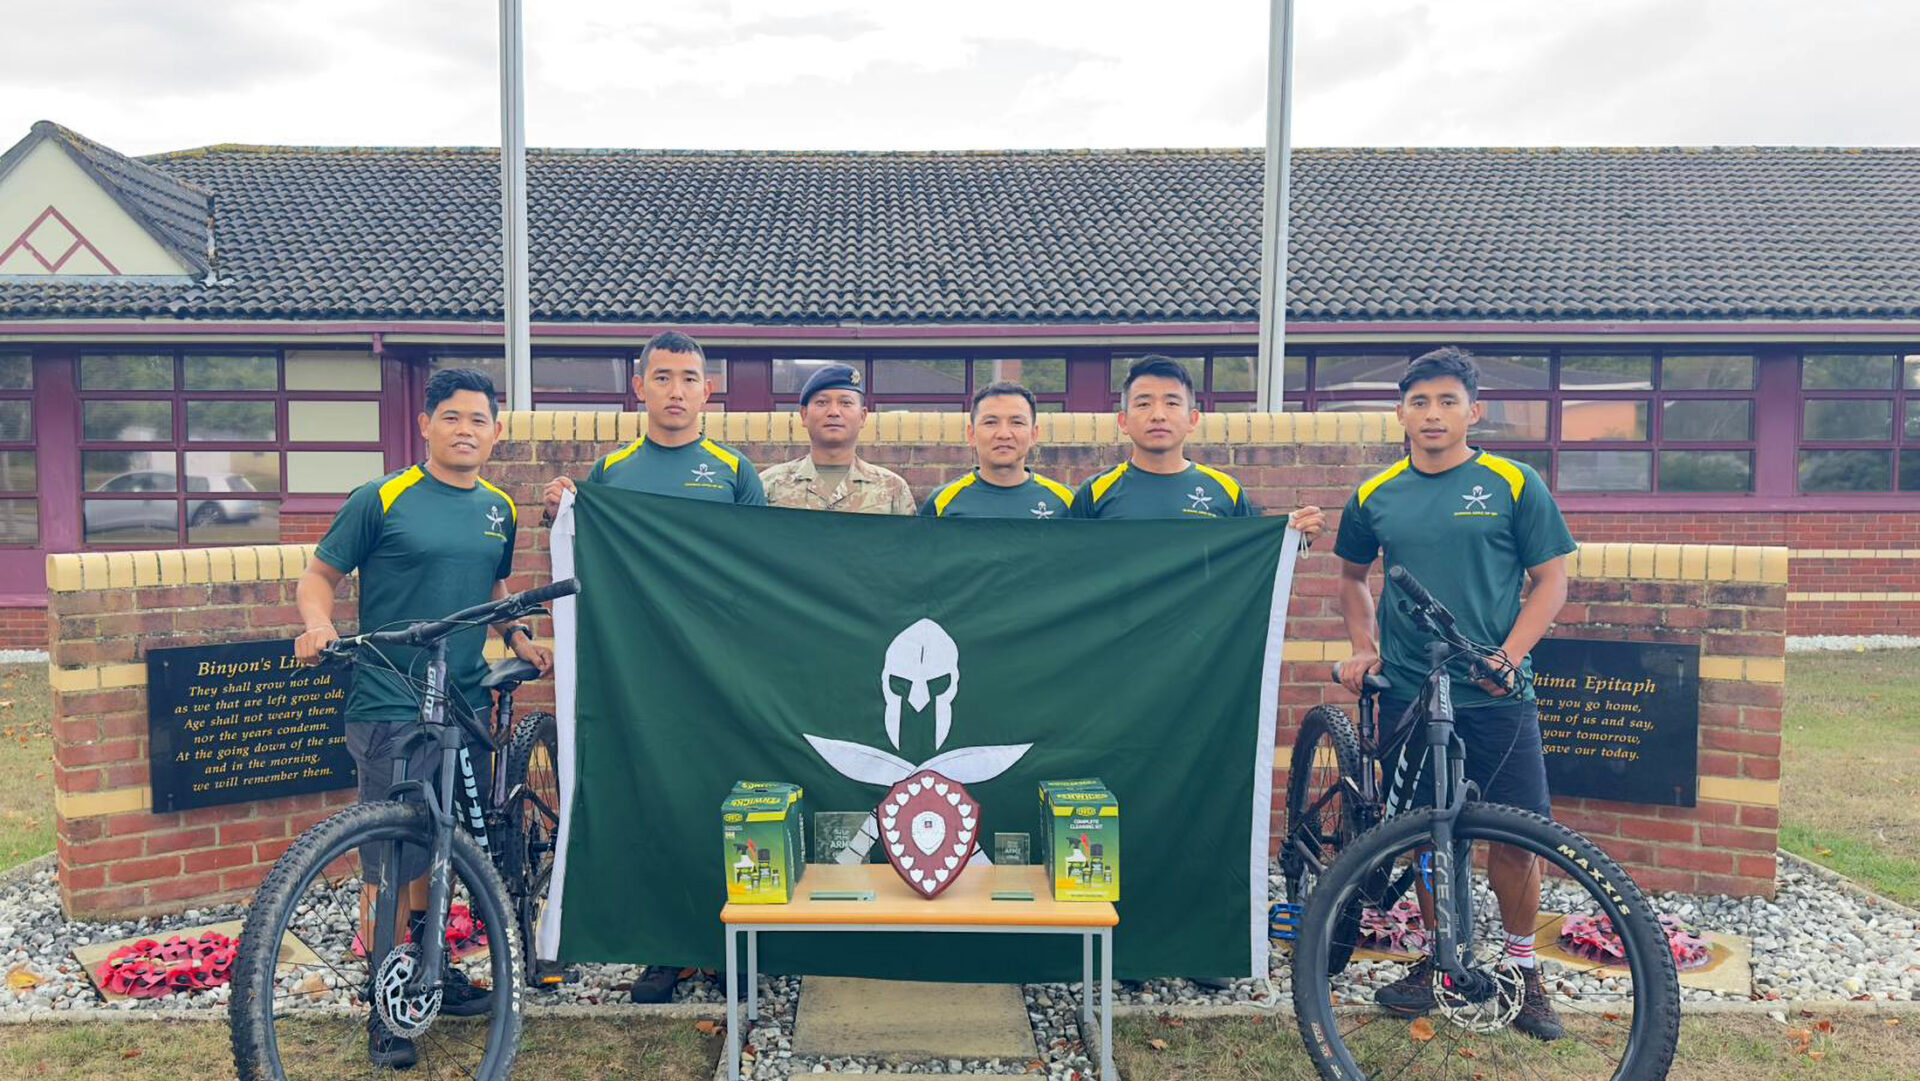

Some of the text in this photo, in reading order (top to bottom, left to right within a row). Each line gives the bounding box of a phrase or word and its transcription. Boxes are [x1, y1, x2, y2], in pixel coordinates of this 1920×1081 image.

[197, 655, 306, 678] Binyon's Lin
[189, 675, 331, 698] They shall grow not old
[1533, 672, 1656, 696] hima Epitaph
[174, 688, 345, 714] as we that are left grow old;
[1558, 699, 1581, 710] you
[1584, 701, 1600, 712] go
[1605, 700, 1641, 713] home,
[184, 718, 206, 731] Age
[210, 714, 239, 726] shall
[243, 713, 264, 724] not
[268, 709, 303, 721] weary
[1537, 711, 1654, 731] hem of us and say,
[194, 722, 330, 744] nor the years condemn.
[1542, 729, 1641, 745] your tomorrow,
[175, 736, 347, 762] At the going down of the sun
[1542, 743, 1640, 762] gave our today.
[204, 753, 321, 775] and in the morning,
[193, 766, 333, 792] we will remember them.
[1557, 844, 1631, 916] MAXXIS
[505, 927, 521, 1014] MAXXIS
